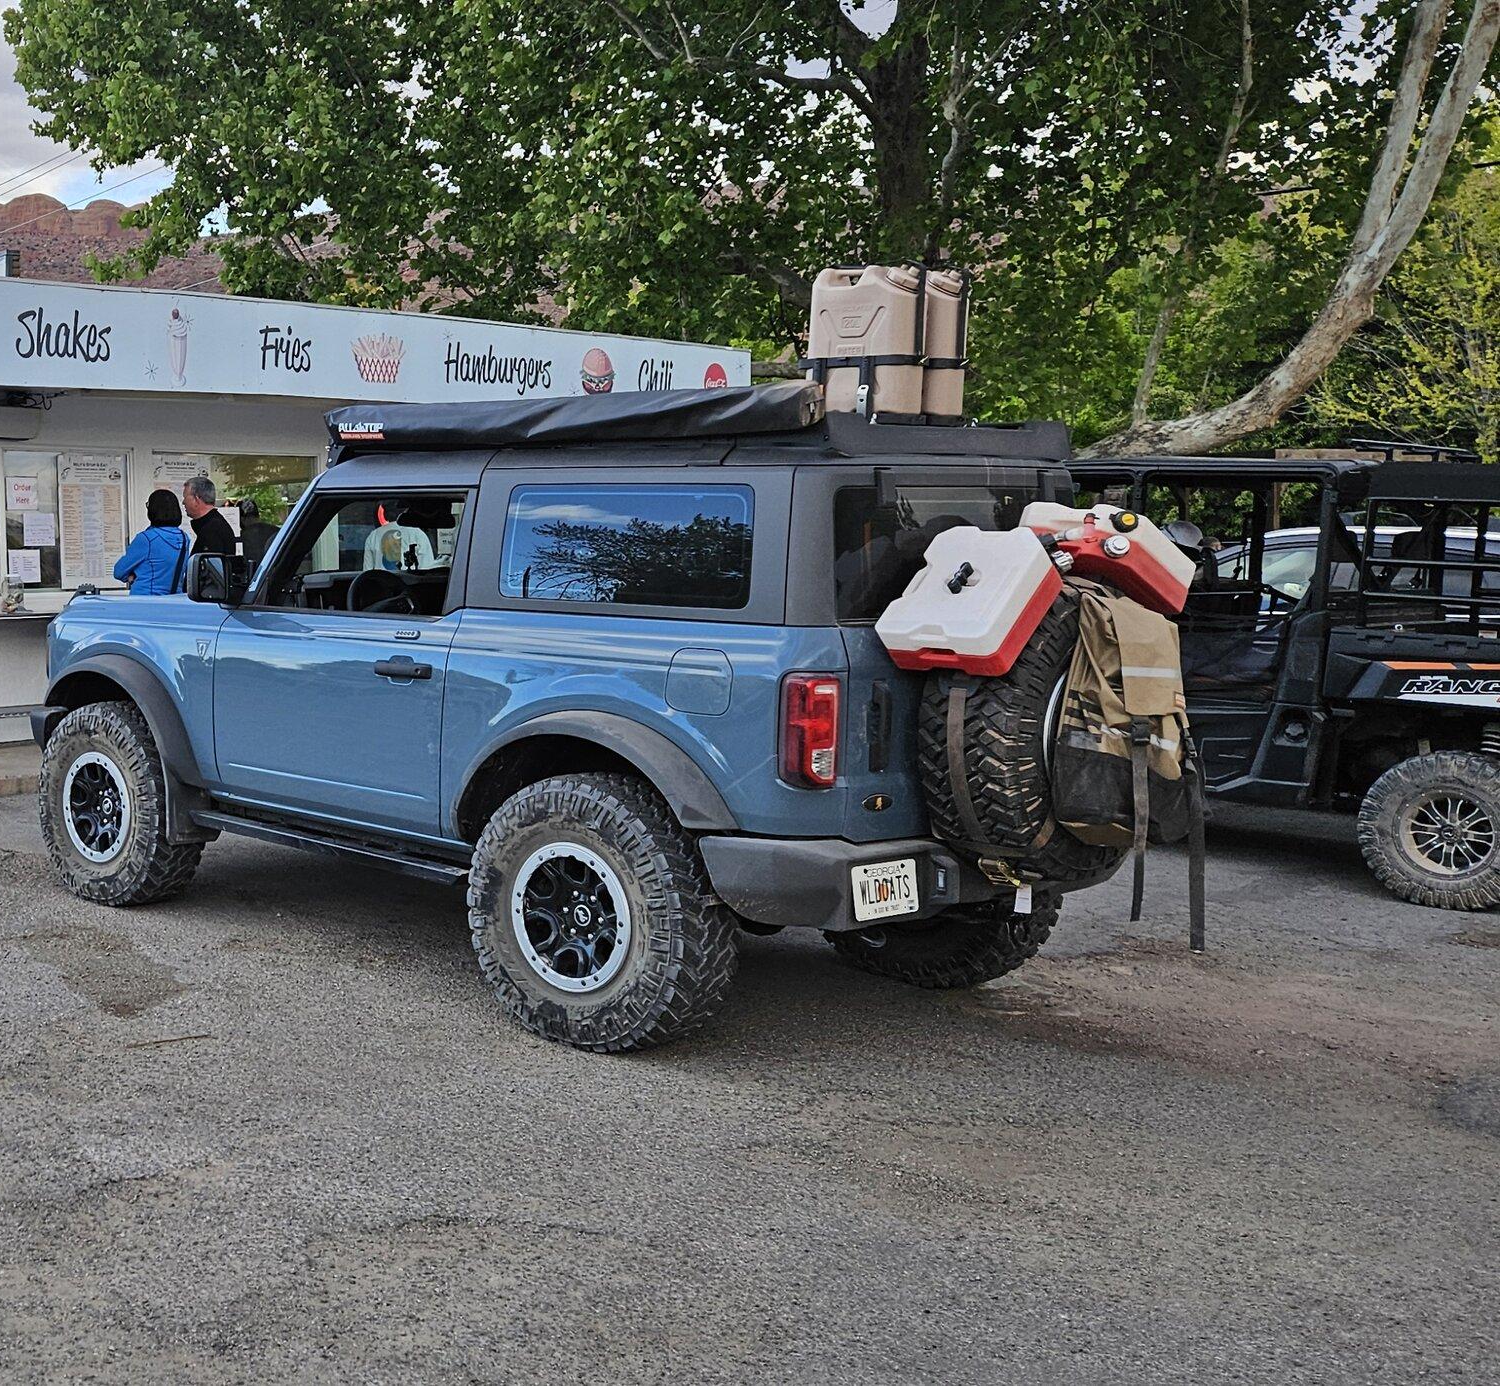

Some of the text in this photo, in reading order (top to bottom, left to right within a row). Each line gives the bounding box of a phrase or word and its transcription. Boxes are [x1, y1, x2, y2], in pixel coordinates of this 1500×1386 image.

[15, 306, 113, 363] Shakes
[259, 325, 312, 374] Fries
[444, 341, 552, 396] Hamburgers
[638, 358, 674, 392] Chili
[866, 865, 901, 878] GEORGIA
